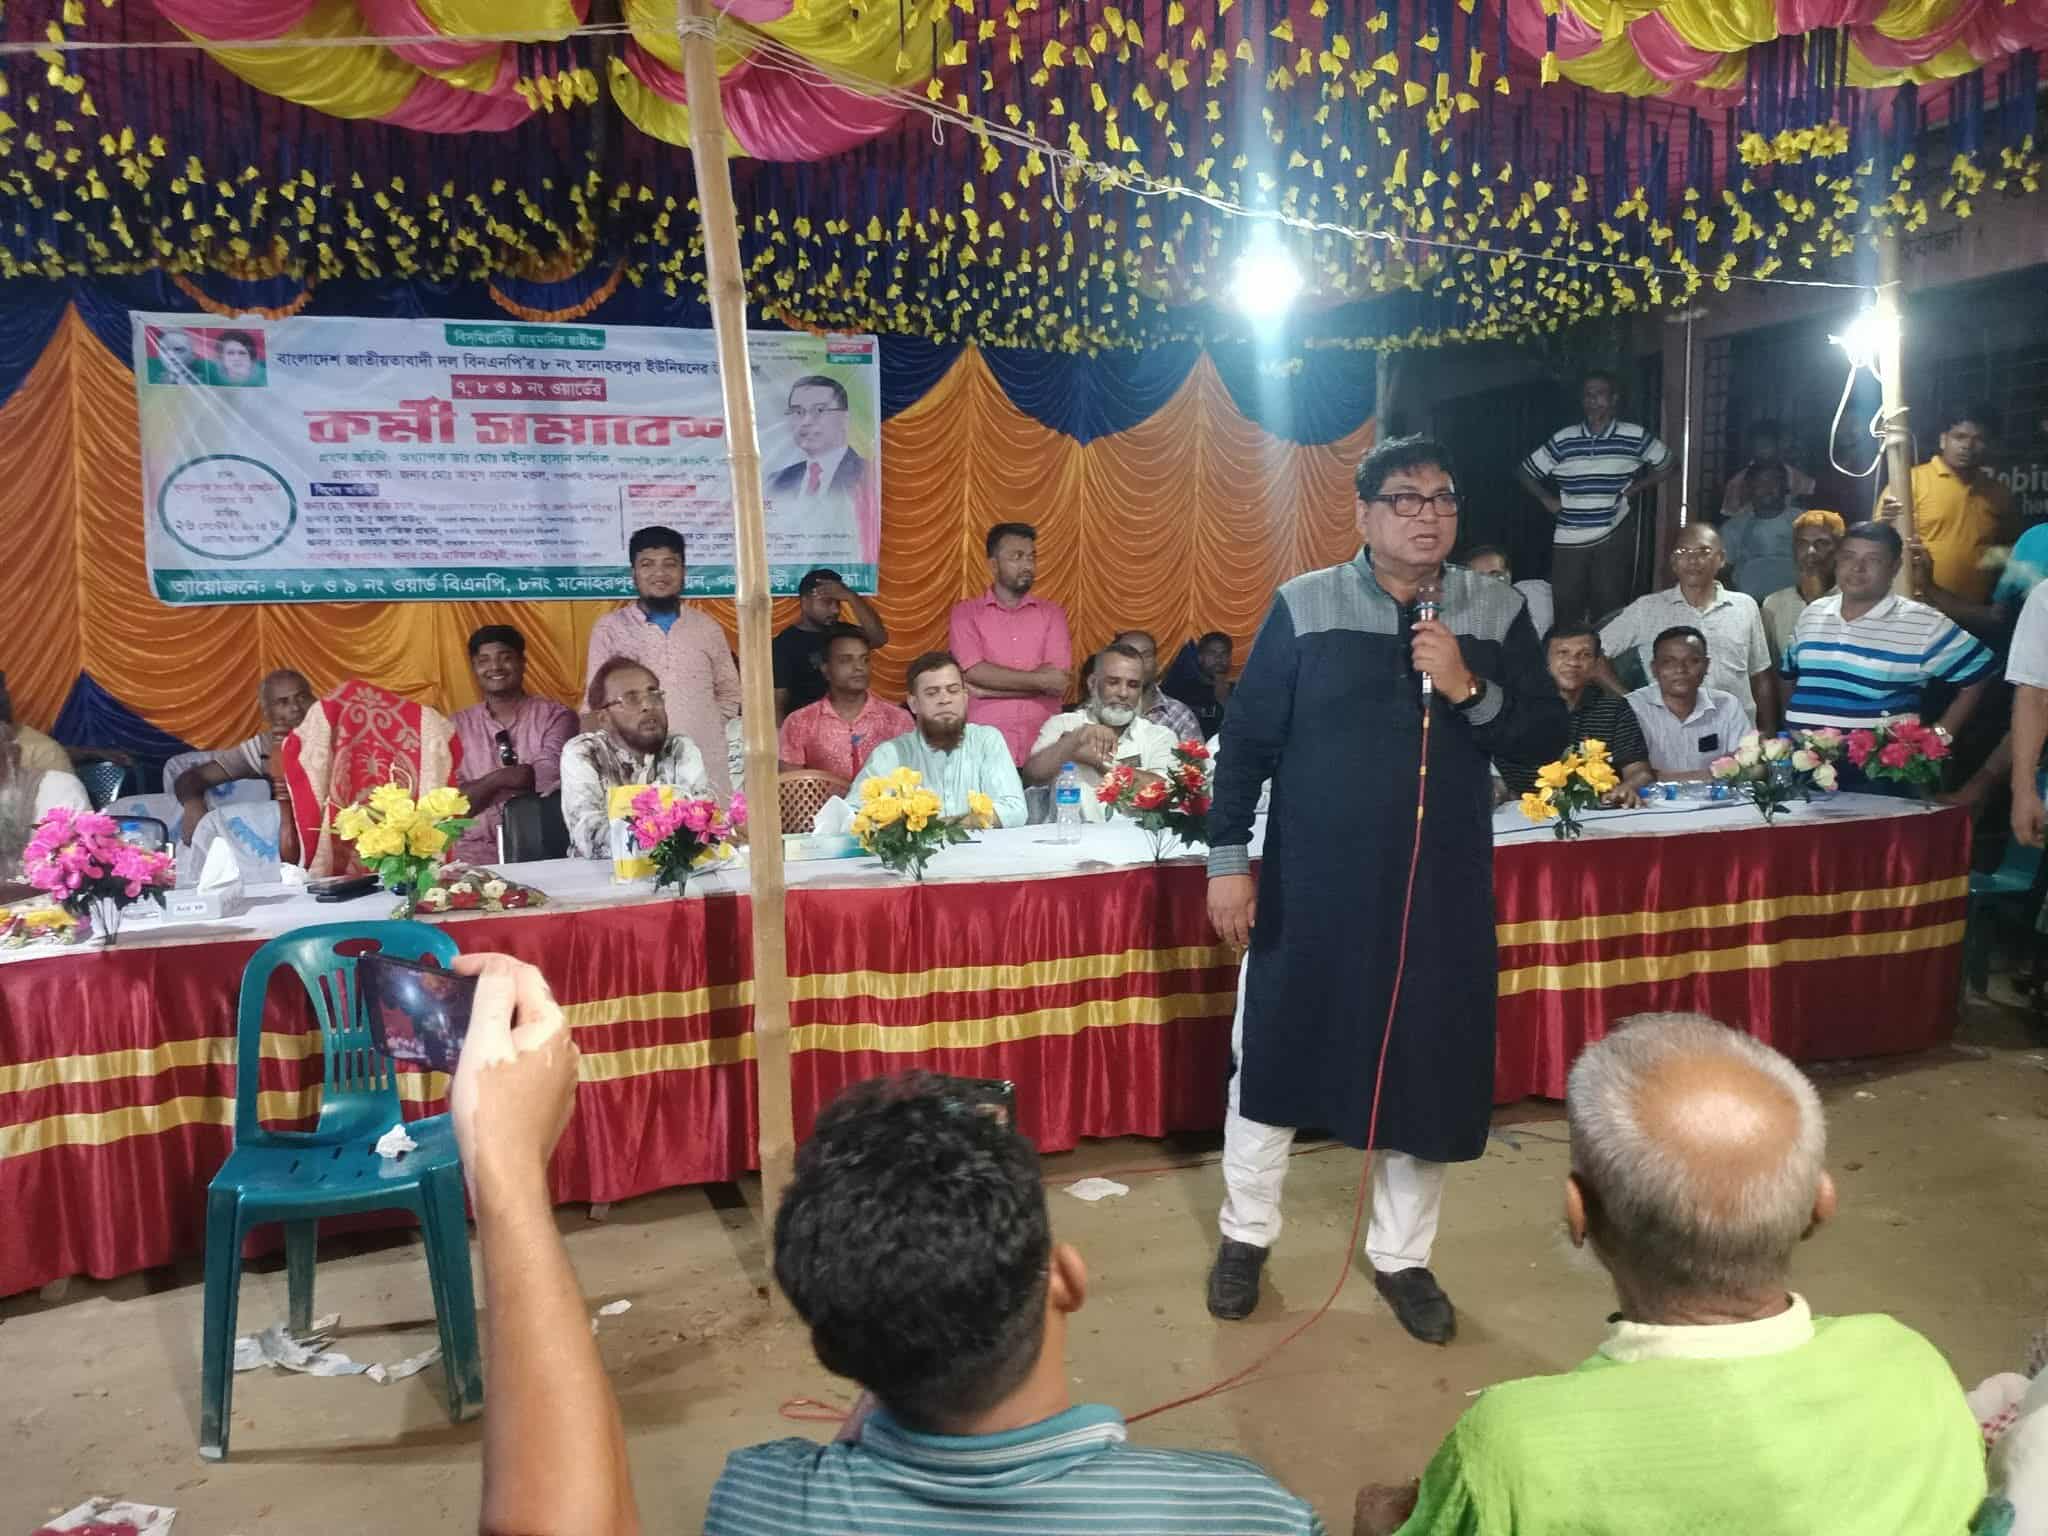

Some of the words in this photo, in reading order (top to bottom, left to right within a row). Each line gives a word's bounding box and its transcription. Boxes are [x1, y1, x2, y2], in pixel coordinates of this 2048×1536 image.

[275, 352, 341, 368] বাংলাদেশ
[345, 350, 433, 369] জাতীয়তাবাদী
[437, 355, 459, 370] দল
[540, 359, 551, 370] ৮
[556, 358, 573, 374] নং
[575, 358, 641, 376] মনোহরপুর
[643, 357, 709, 375] ইউনিয়নের
[477, 381, 489, 394] ৮
[495, 380, 507, 394] ও
[511, 381, 523, 395] ৯
[526, 382, 547, 397] নং
[551, 379, 602, 397] ওয়ার্ডের
[304, 396, 457, 444] কর্মী
[301, 580, 316, 594] ৮
[323, 579, 338, 594] ও
[344, 579, 358, 594] ৯
[363, 578, 388, 595] নং
[392, 573, 438, 594] ওয়ার্ড
[443, 573, 512, 595] বিএনপি,
